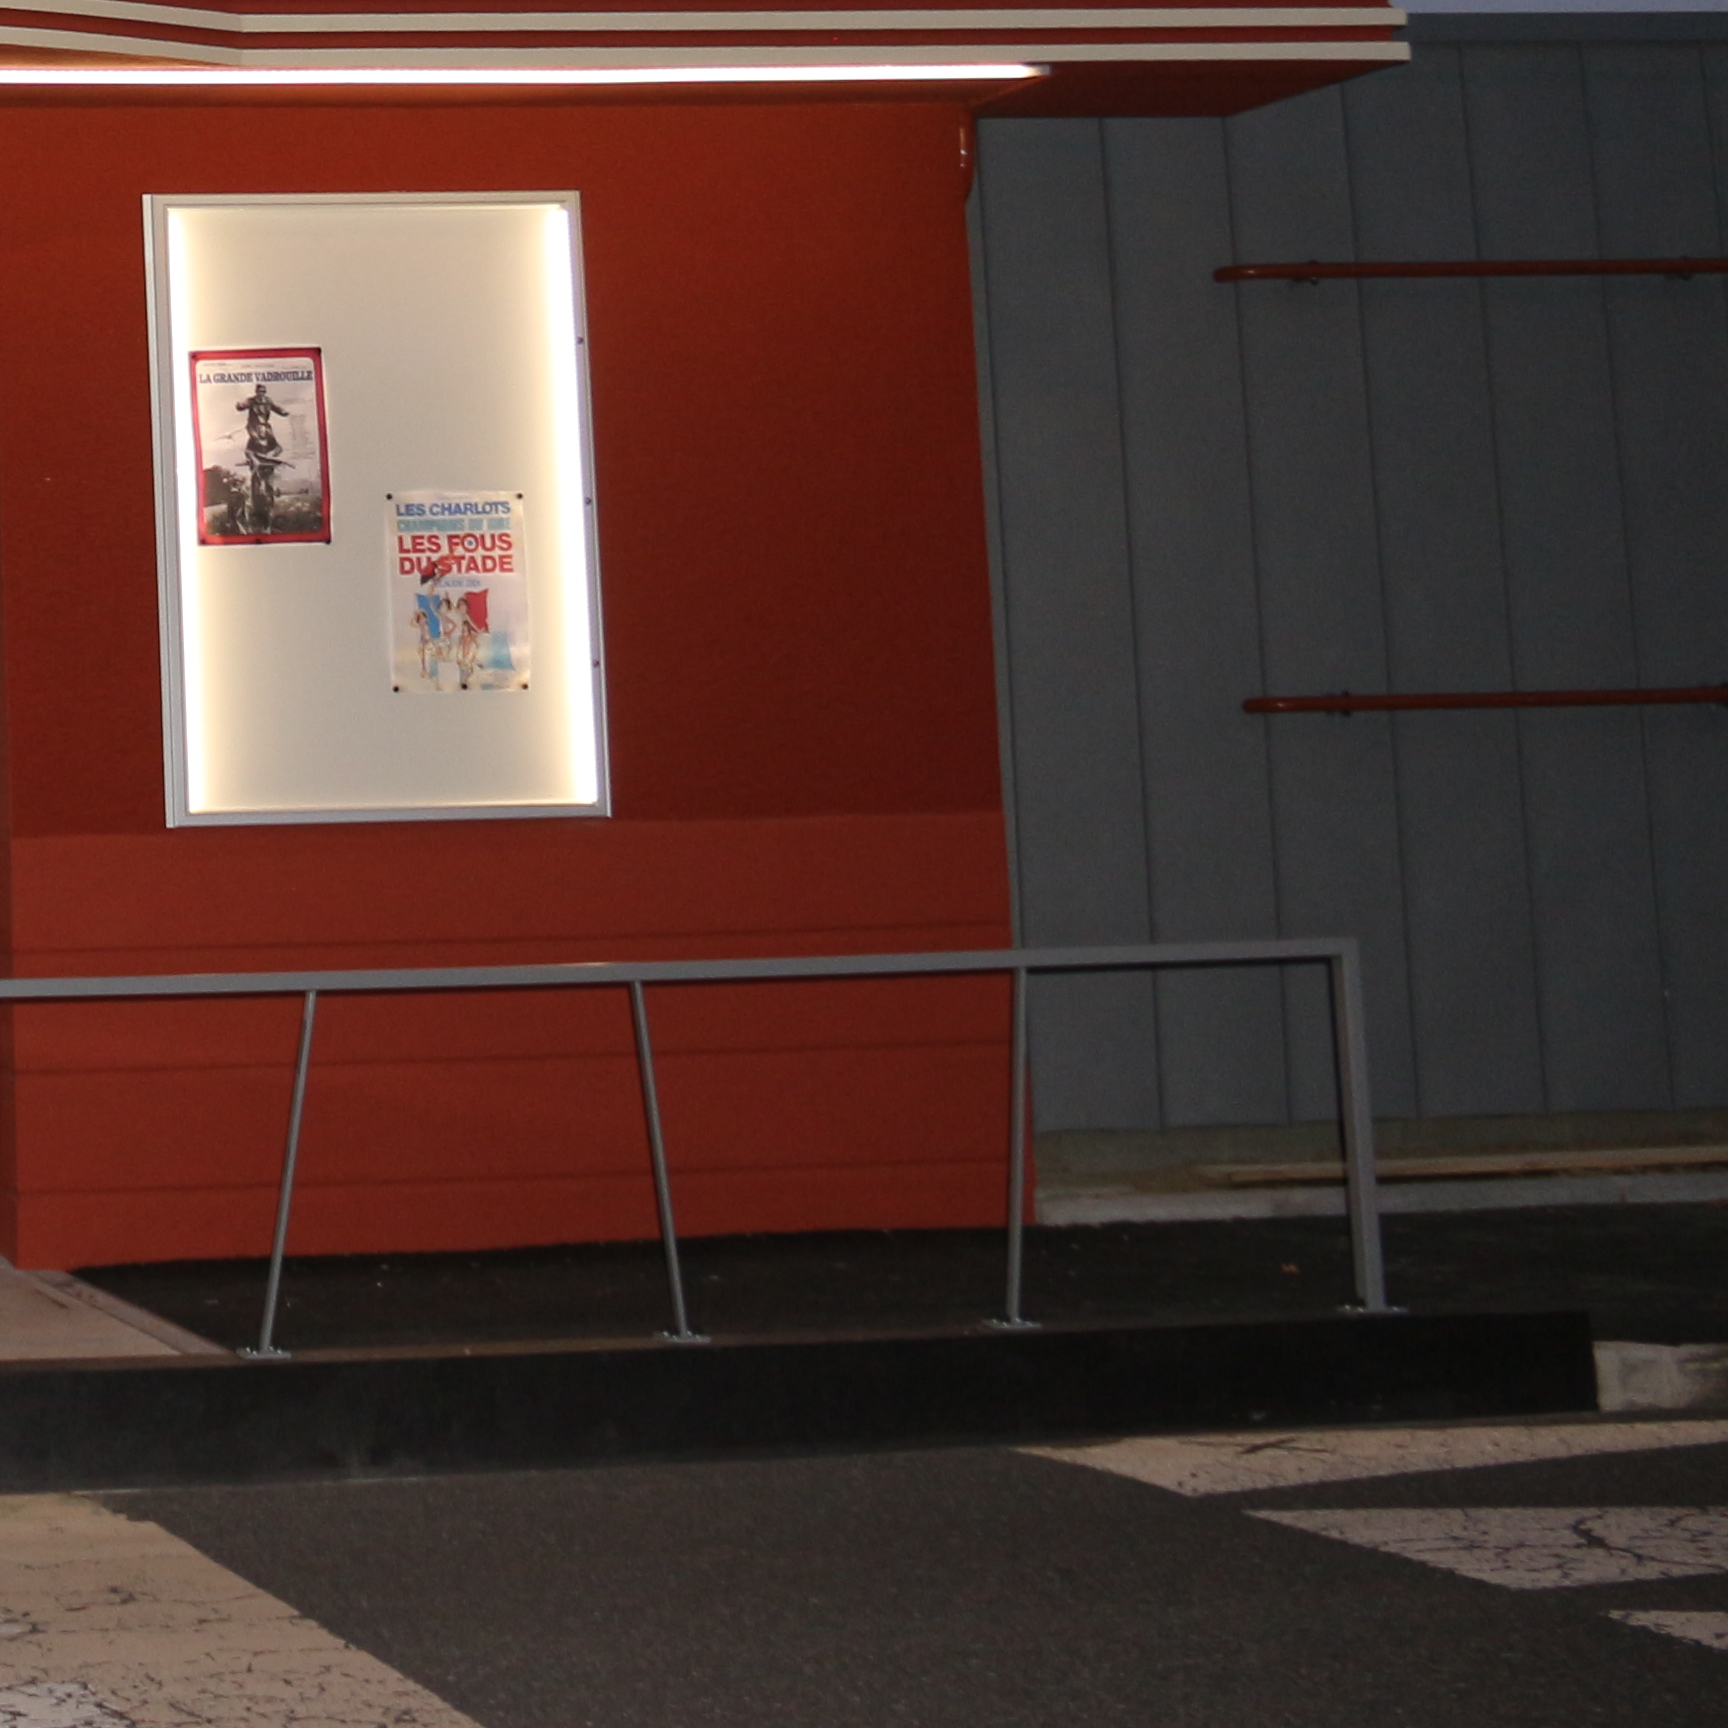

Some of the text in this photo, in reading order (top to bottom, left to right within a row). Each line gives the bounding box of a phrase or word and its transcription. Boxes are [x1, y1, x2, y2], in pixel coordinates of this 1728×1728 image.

[199, 370, 313, 384] LA GRANDE VADROUILLE
[396, 501, 511, 517] LES CHARLOTS
[397, 532, 513, 554] LES FOUS
[399, 554, 514, 576] DU STADE
